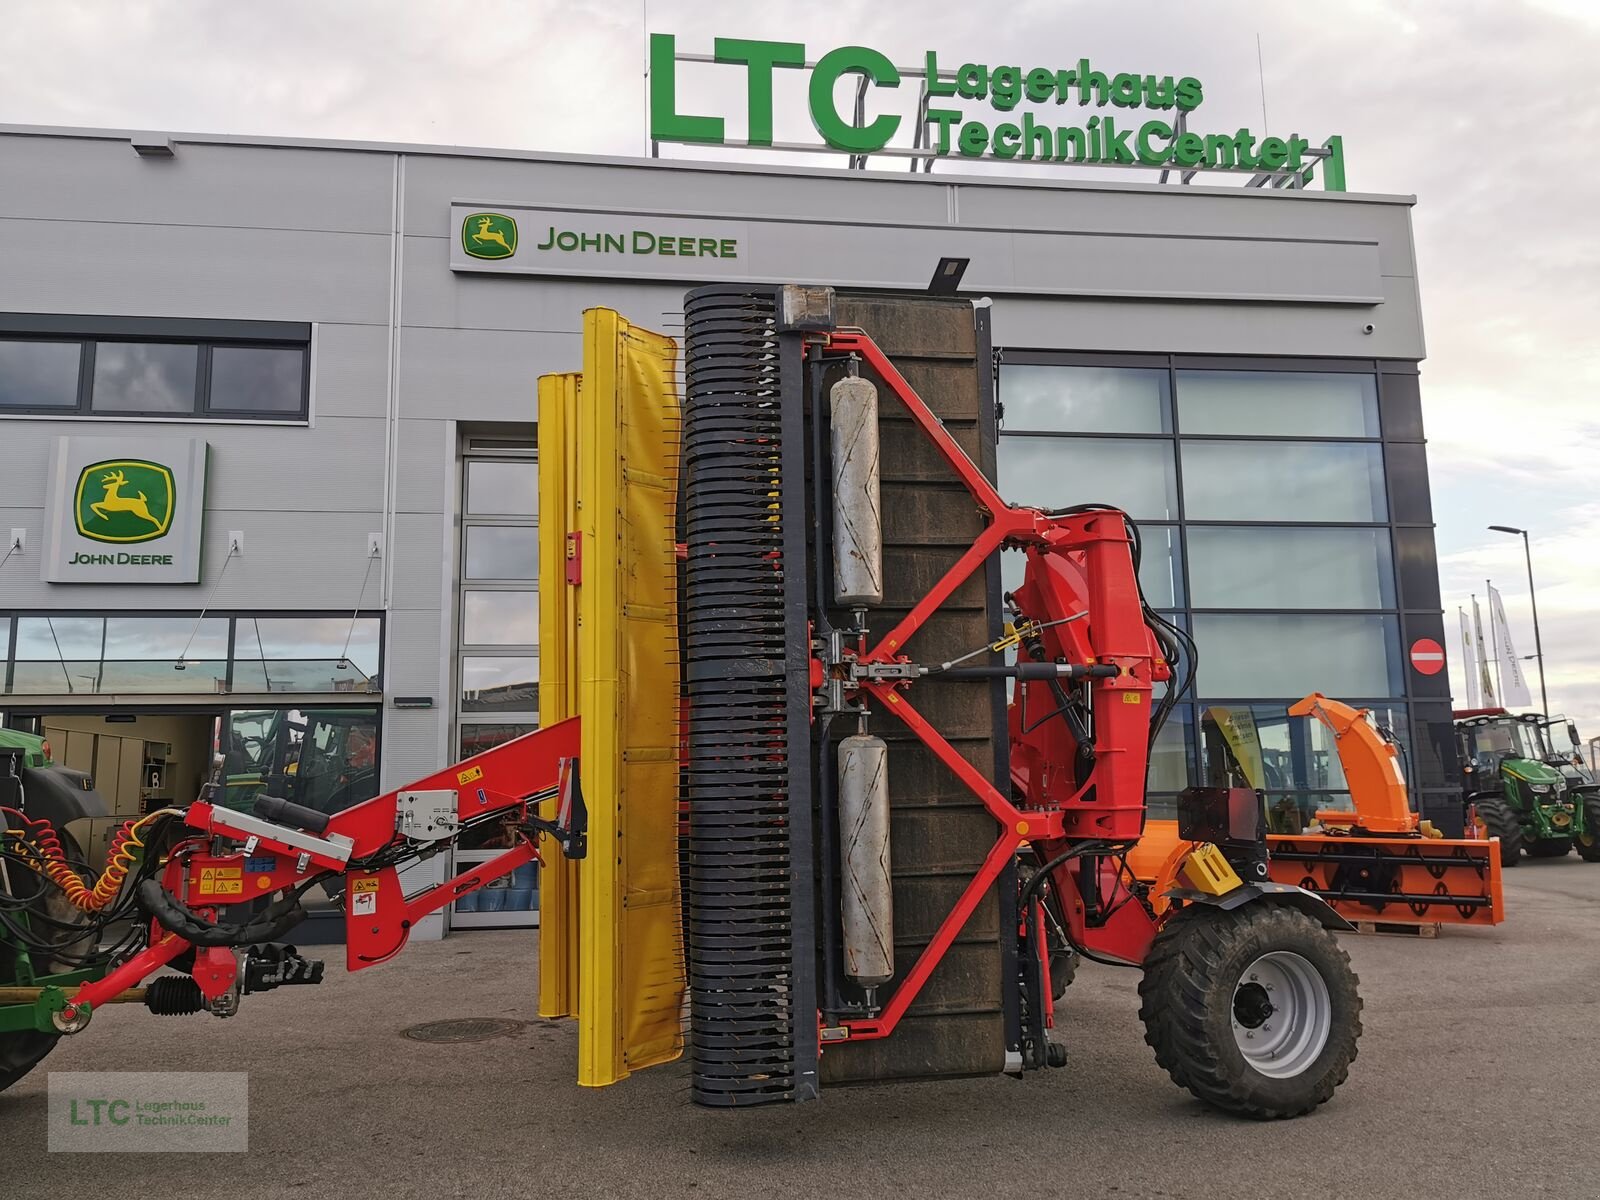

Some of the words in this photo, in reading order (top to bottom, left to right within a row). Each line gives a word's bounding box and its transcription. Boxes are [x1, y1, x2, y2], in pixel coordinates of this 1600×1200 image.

[650, 33, 902, 153] LTC
[925, 51, 1203, 112] Lagerhaus
[926, 111, 1308, 173] TechnikCenter
[537, 227, 625, 253] JOHN
[632, 230, 737, 258] DEERE
[68, 552, 114, 565] JOHN
[117, 552, 173, 565] DEERE
